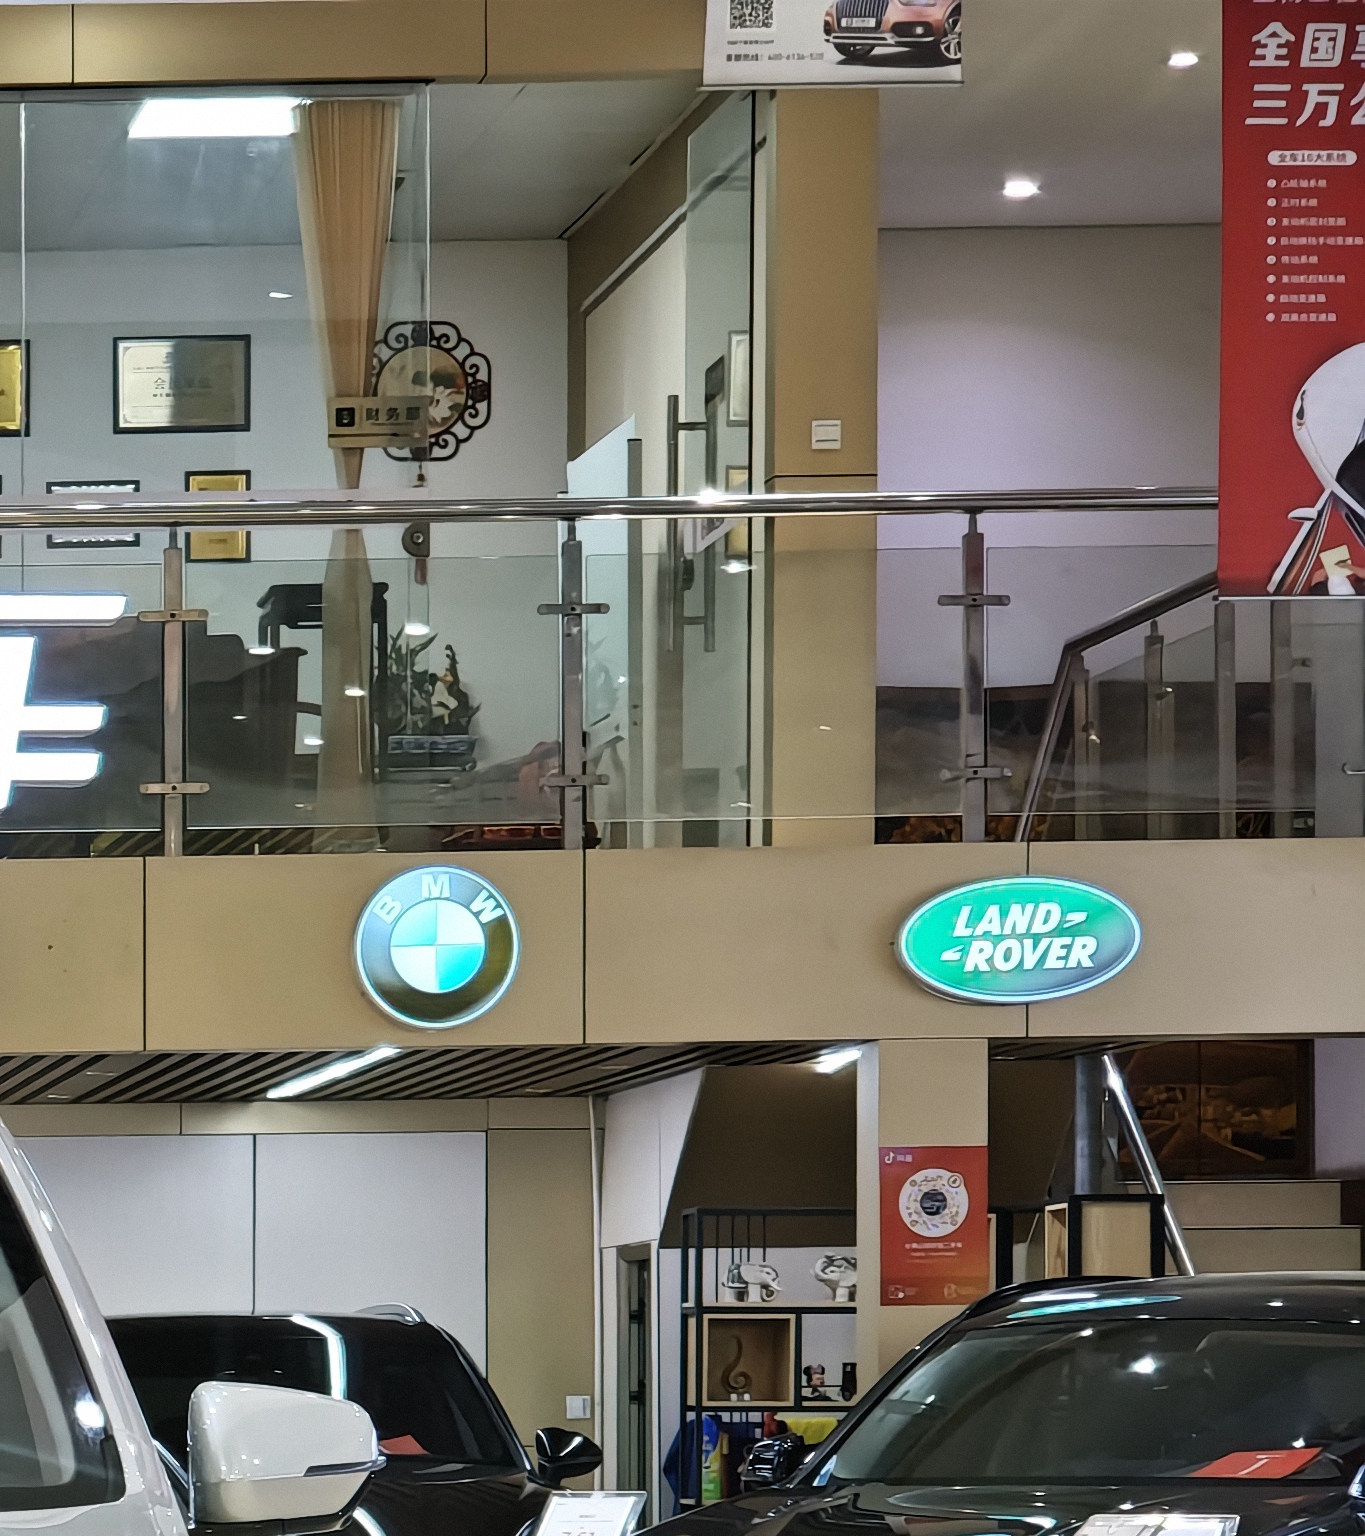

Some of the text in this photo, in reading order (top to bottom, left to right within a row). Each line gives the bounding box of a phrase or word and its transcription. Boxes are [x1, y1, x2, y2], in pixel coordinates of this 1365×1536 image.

[372, 872, 505, 925] BMW
[952, 902, 1062, 937] LAND
[963, 935, 1098, 973] ROVER
